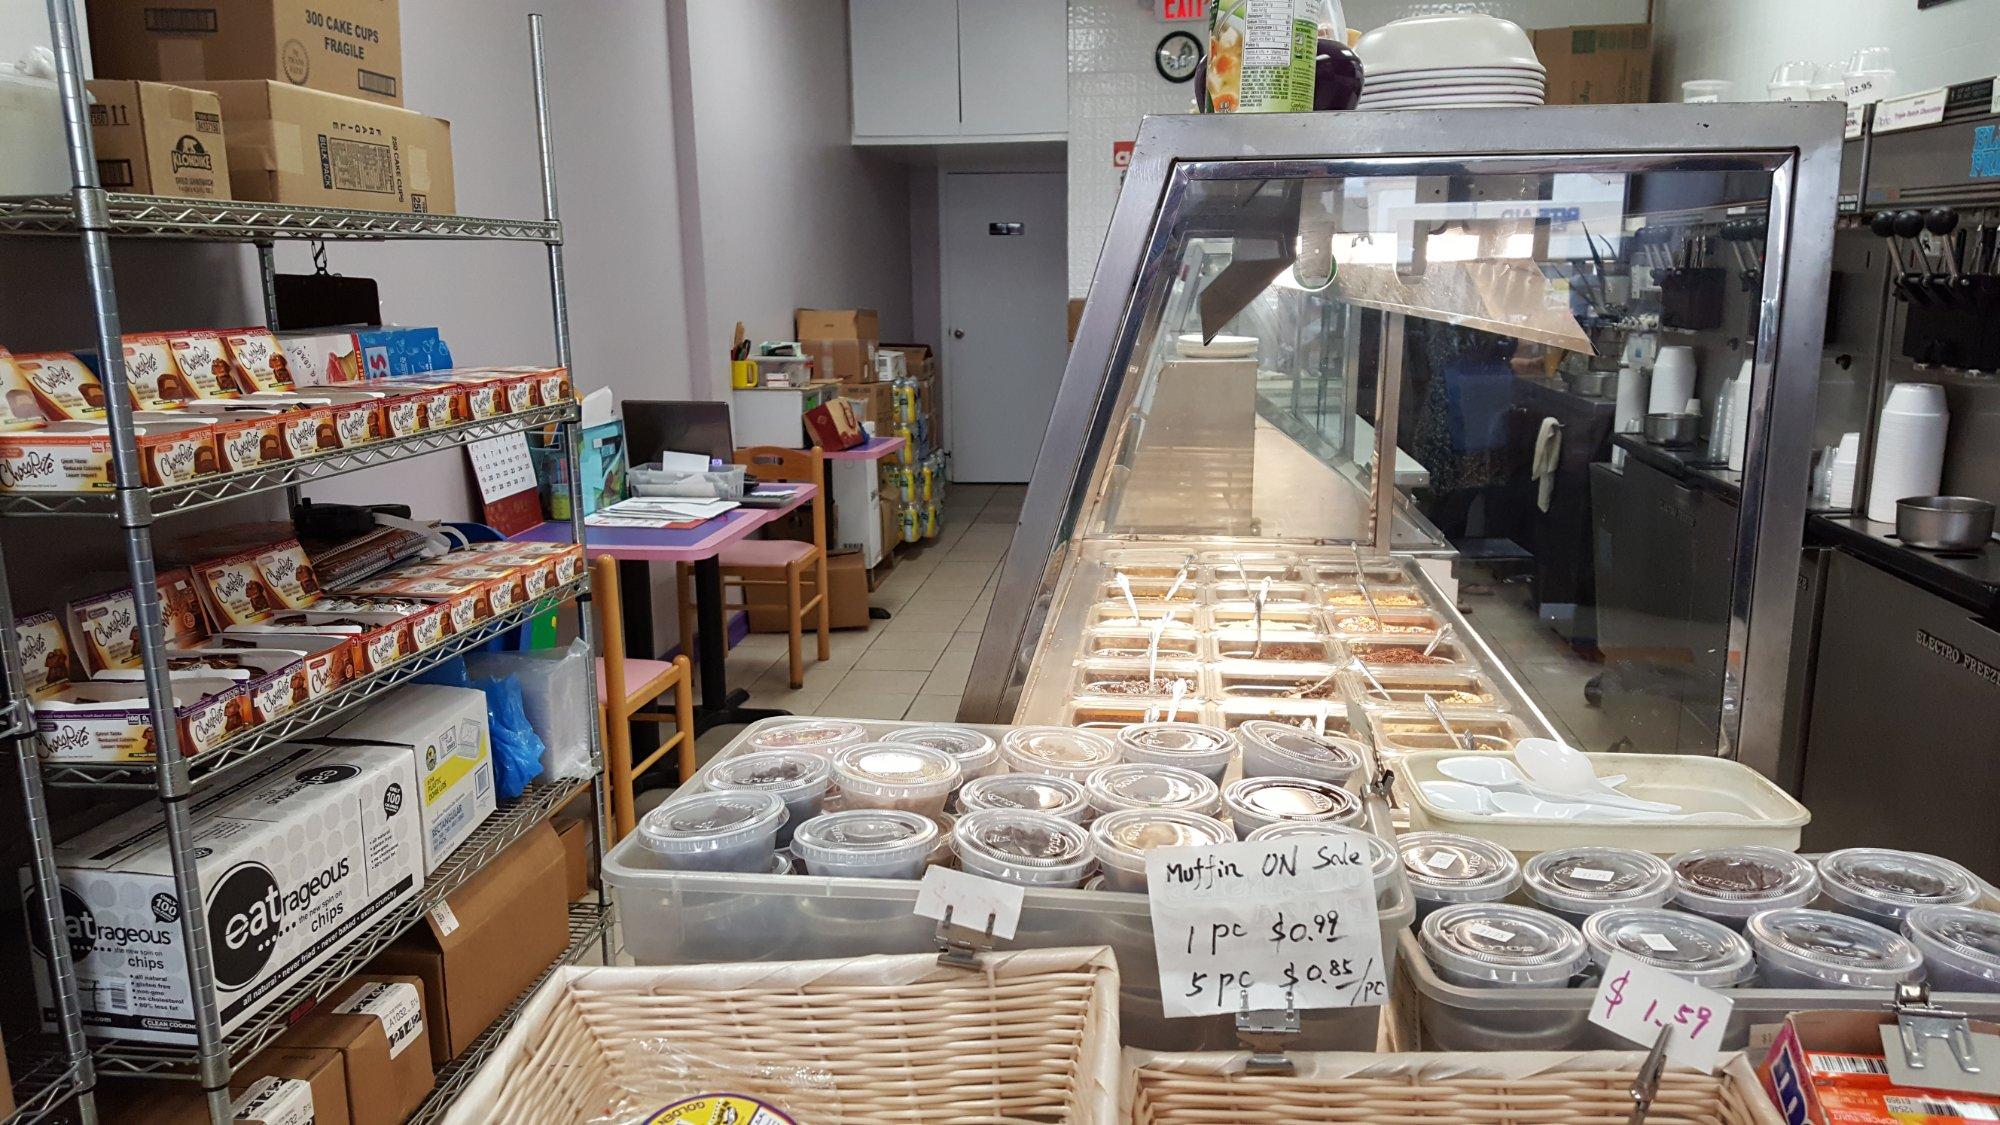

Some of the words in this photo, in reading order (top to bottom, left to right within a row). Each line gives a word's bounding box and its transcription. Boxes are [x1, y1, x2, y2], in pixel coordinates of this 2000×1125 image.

[305, 9, 323, 27] 300
[326, 16, 353, 35] CAKE
[355, 24, 379, 43] CUPS
[324, 37, 365, 60] FRAGILE
[171, 150, 213, 174] KLONDIKE
[179, 346, 212, 377] ChocoRite
[161, 443, 194, 477] ChocoRite
[230, 430, 260, 463] ChocoRite
[0, 451, 55, 488] ChocoRite
[216, 570, 246, 604] ChocoRite
[266, 556, 295, 588] ChocoRite
[95, 608, 132, 647] ChocoRite
[1916, 630, 1960, 664] ELECTRO
[263, 678, 290, 715] ChocoRite
[195, 706, 225, 744] ChocoRite
[386, 792, 401, 806] 100
[1165, 859, 1244, 891] Muffin
[1262, 844, 1299, 878] ON
[1312, 841, 1364, 870] Sale
[156, 898, 178, 917] 100
[225, 857, 350, 950] eatrageous
[309, 906, 322, 919] new
[322, 896, 336, 911] spin
[335, 890, 343, 900] on
[311, 902, 344, 933] chips
[65, 911, 172, 946] atrageous
[1211, 921, 1248, 956] pc
[1270, 909, 1340, 955] $0.99
[128, 956, 165, 971] chips
[242, 993, 252, 1007] all
[253, 976, 277, 1000] natural
[282, 961, 300, 978] never
[301, 947, 316, 964] fried
[321, 933, 338, 948] never
[339, 918, 356, 935] baked
[374, 887, 397, 910] crunchy
[1185, 971, 1208, 998] 5
[1218, 970, 1254, 1006] pc
[147, 1019, 169, 1027] CLEAN
[656, 1101, 706, 1125] GOLDEN
